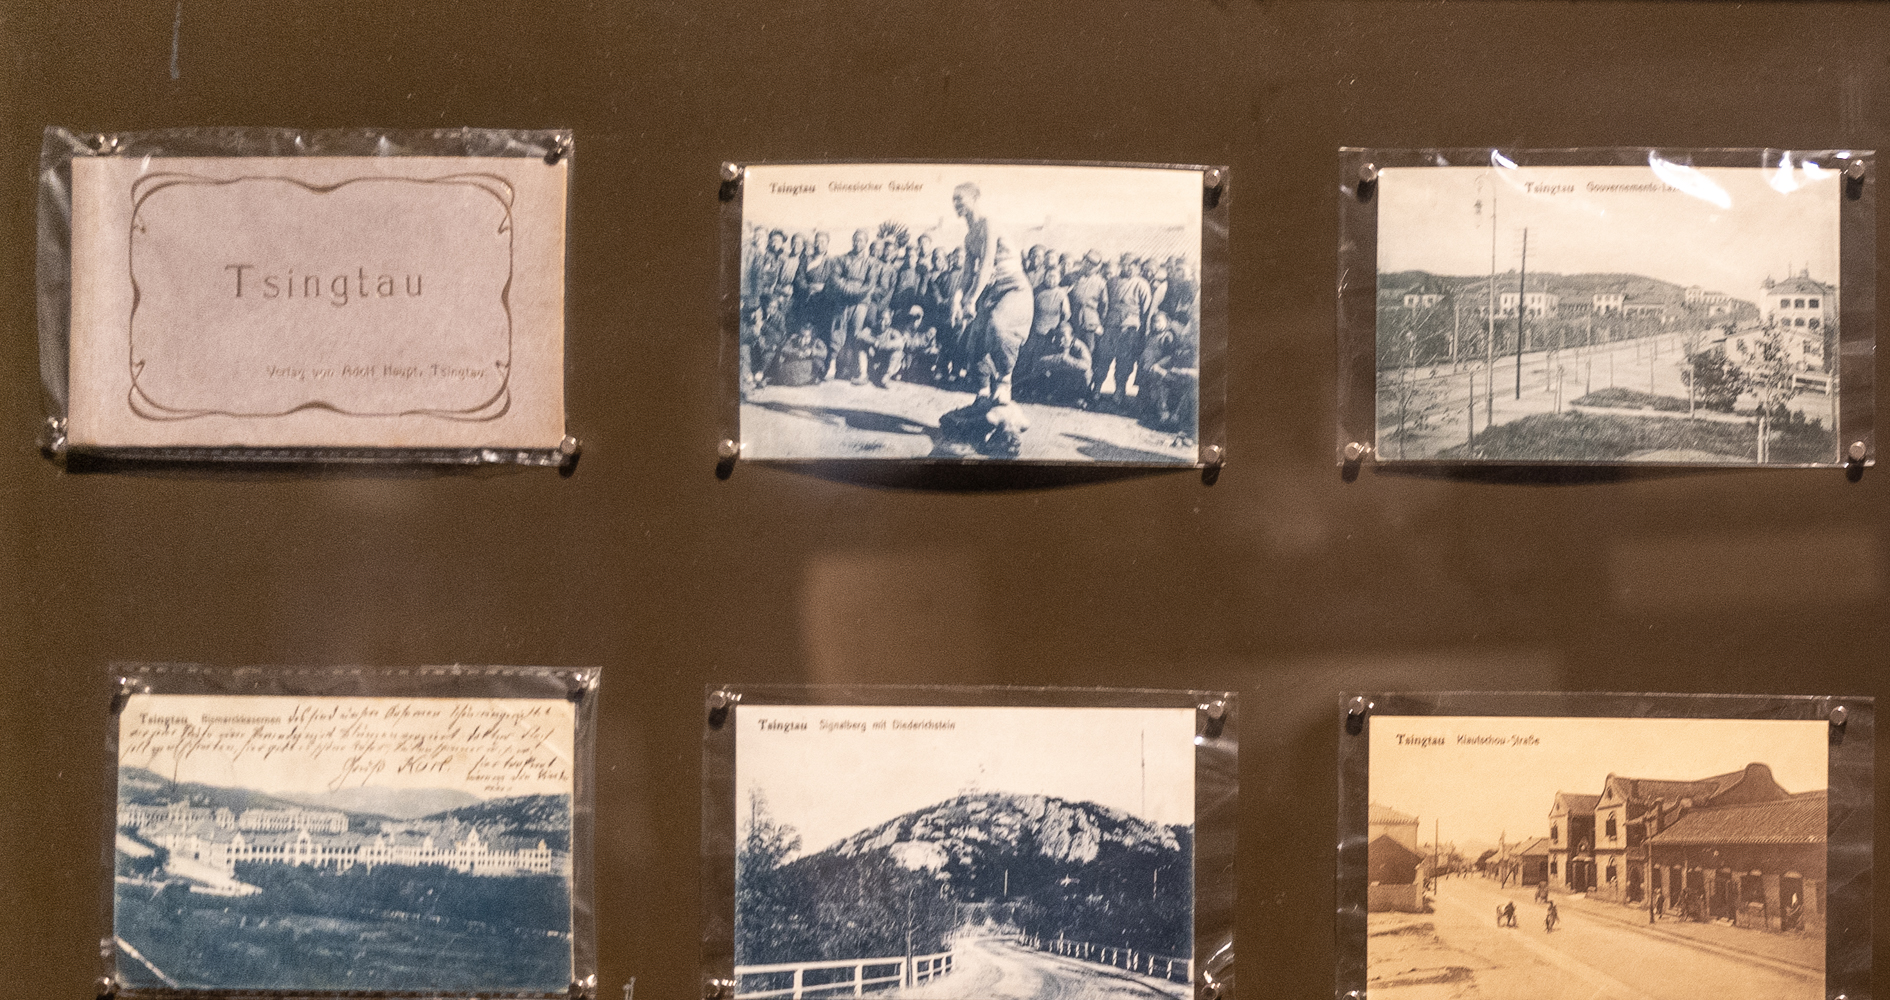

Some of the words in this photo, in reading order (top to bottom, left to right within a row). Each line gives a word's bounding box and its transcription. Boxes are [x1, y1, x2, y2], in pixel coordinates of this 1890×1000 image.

[769, 182, 816, 196] Tsingtau
[1524, 181, 1575, 196] Tsingtau
[224, 263, 423, 307] Tsingtau
[140, 712, 188, 726] Tsingtau
[758, 719, 808, 733] Tsingtau
[819, 719, 867, 733] Signalberg
[872, 719, 887, 730] mit
[1396, 733, 1445, 748] Tsingtau
